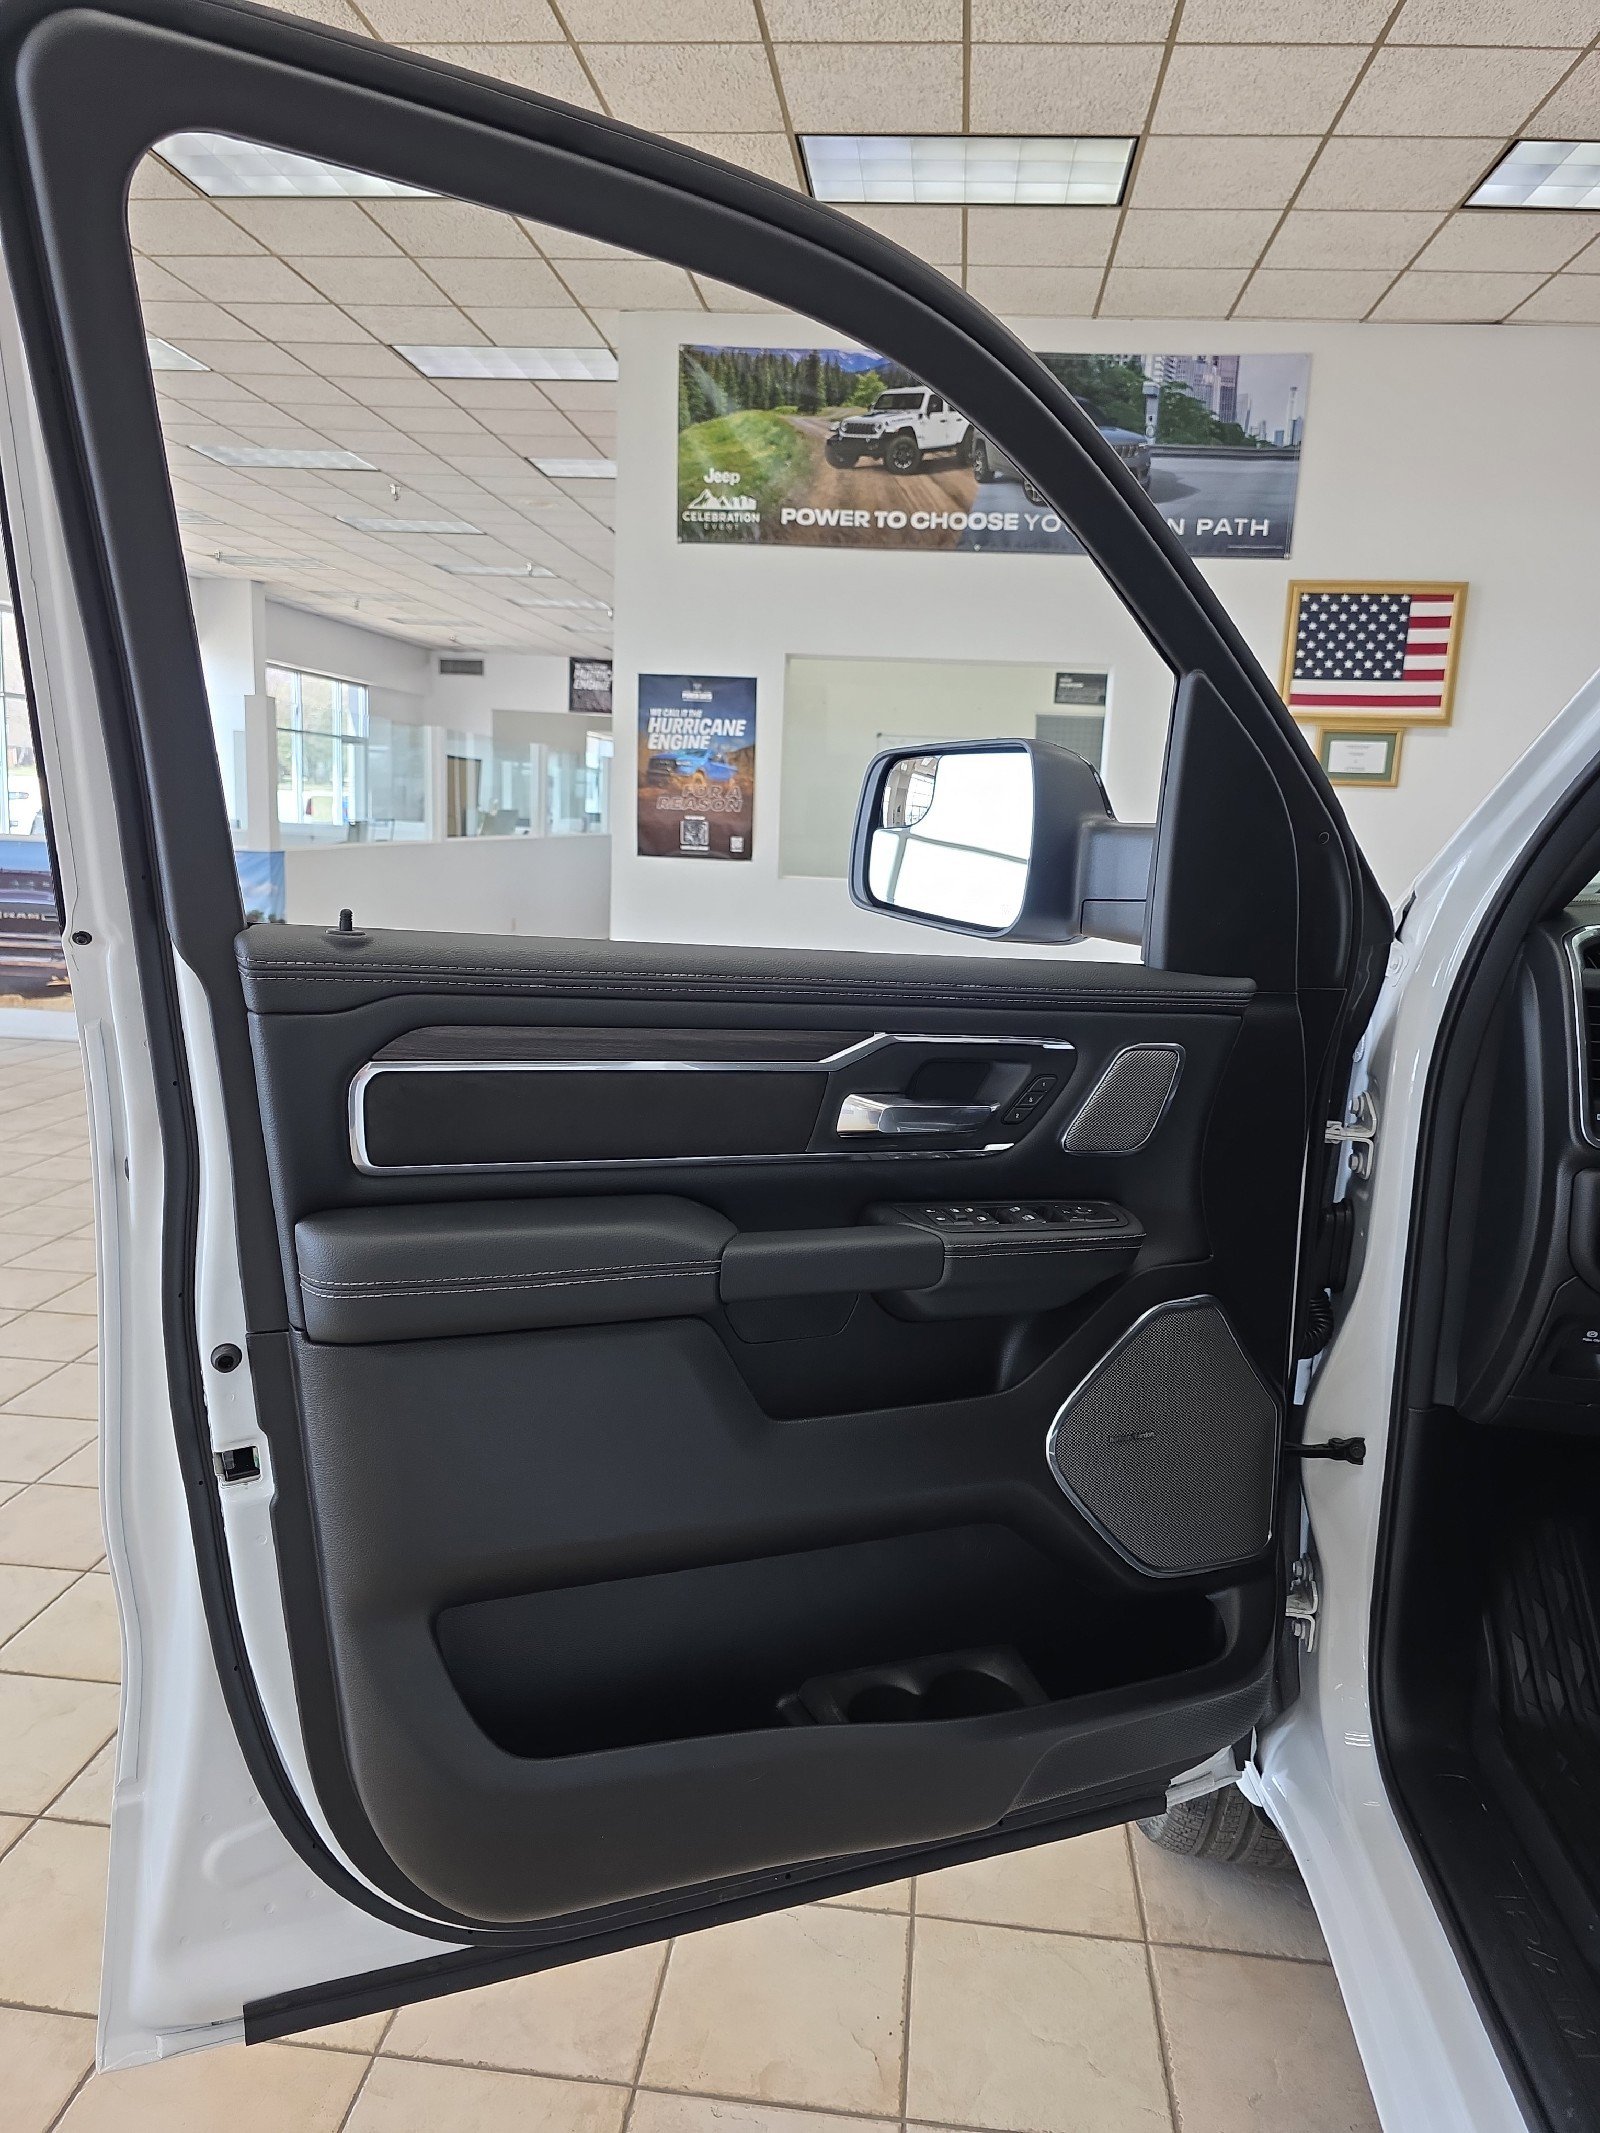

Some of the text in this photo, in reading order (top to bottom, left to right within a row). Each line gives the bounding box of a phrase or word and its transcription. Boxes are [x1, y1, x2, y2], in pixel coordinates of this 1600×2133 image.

[703, 467, 741, 486] Jeep
[682, 510, 761, 523] CELEBRATION
[781, 507, 870, 528] POWER
[874, 510, 907, 530] TO
[910, 510, 1019, 532] CHOOSE
[1024, 512, 1071, 533] YO
[1196, 517, 1270, 537] PATH
[647, 716, 747, 737] HURRICANE
[647, 733, 711, 750] ENGINE
[682, 784, 743, 800] FOR A
[656, 796, 743, 813] REASON
